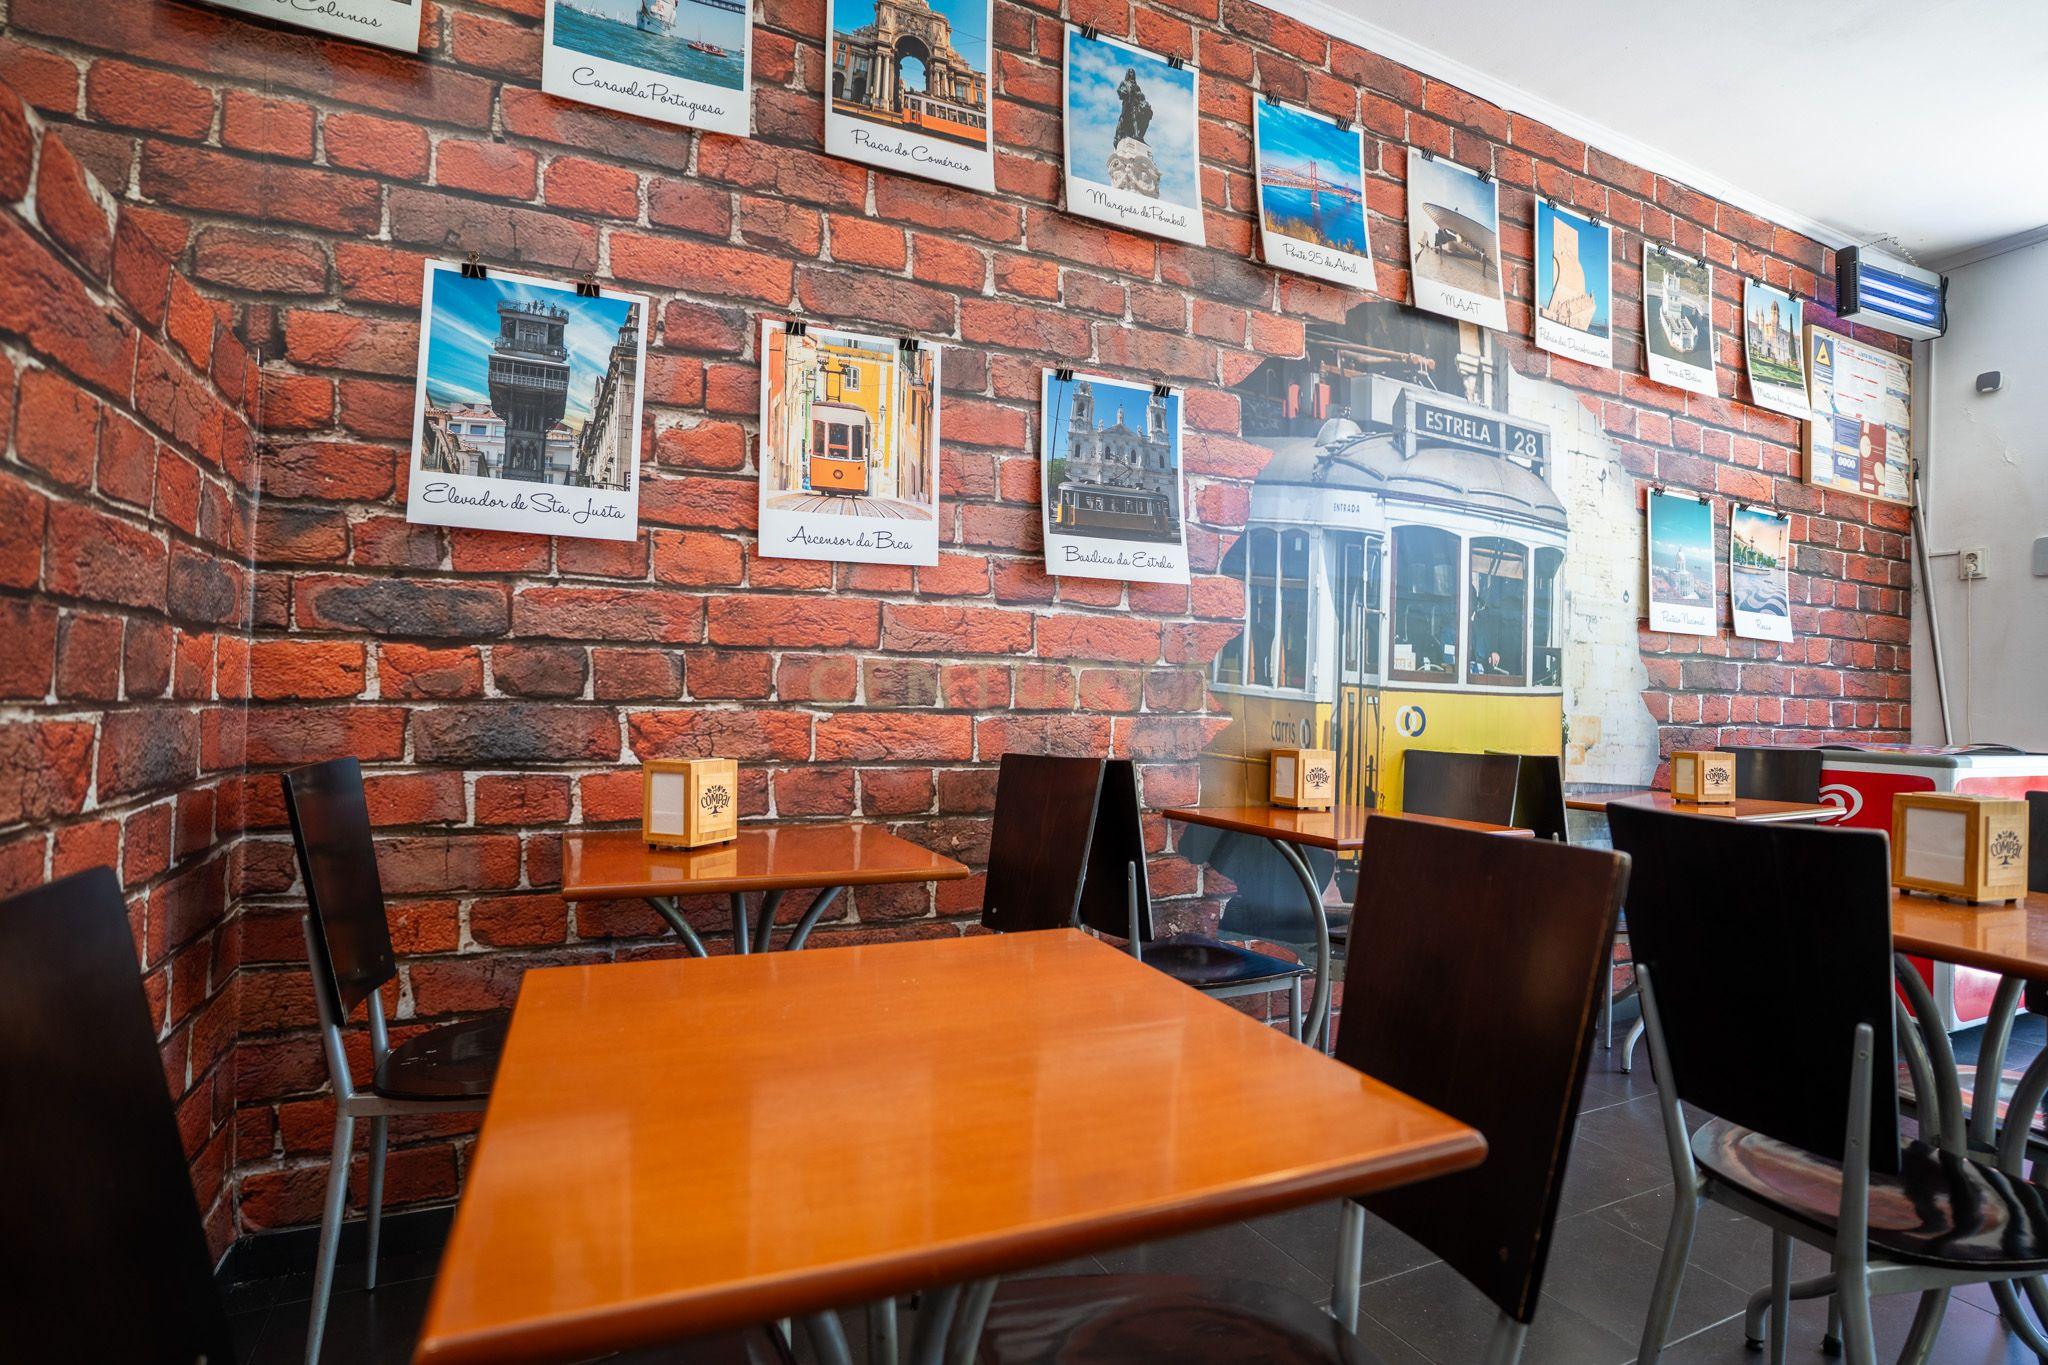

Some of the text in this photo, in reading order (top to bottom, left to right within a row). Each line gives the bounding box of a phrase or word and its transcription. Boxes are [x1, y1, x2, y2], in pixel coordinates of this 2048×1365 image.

[572, 66, 725, 121] Caravela Portuguesa
[851, 129, 971, 172] Praça do Comércio
[1140, 205, 1151, 218] de
[1149, 205, 1187, 228] Pombal
[1308, 250, 1323, 265] 25
[1333, 257, 1359, 274] Abril
[1440, 292, 1482, 316] MAAT
[1425, 409, 1537, 458] ESTRELA 28
[422, 482, 625, 524] Elevador de Sta. Justa
[1333, 502, 1360, 513] ENTRADA
[786, 525, 913, 550] Ascensor da Bica
[1116, 551, 1131, 566] da
[1131, 551, 1175, 569] Estrela
[1271, 712, 1296, 745] carris
